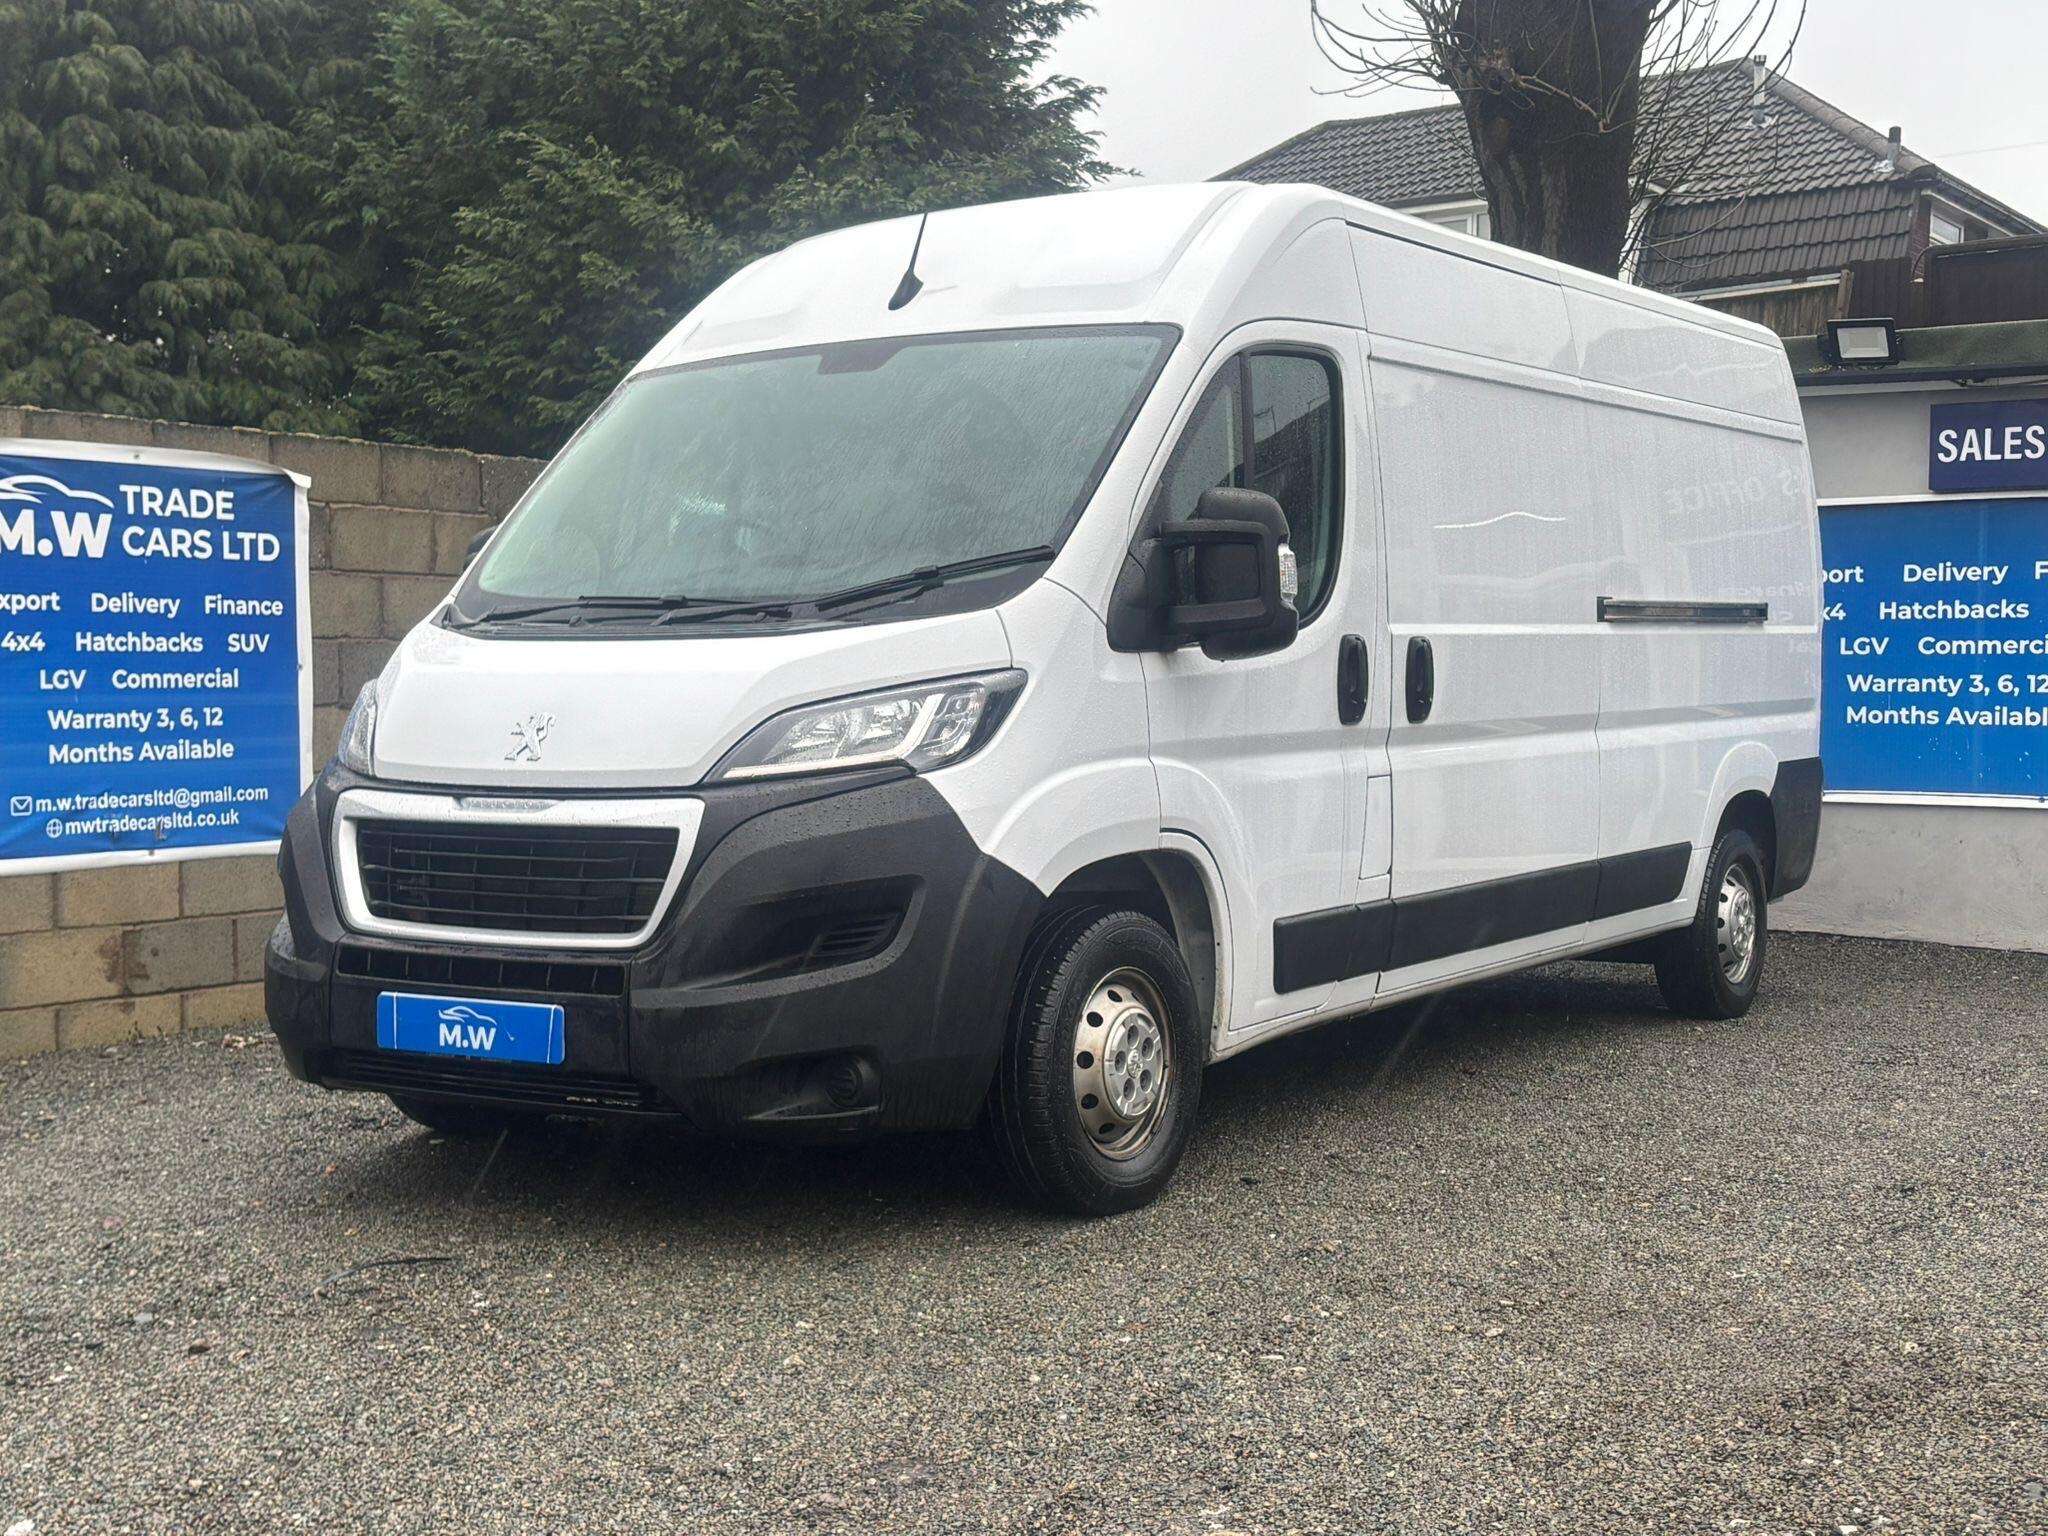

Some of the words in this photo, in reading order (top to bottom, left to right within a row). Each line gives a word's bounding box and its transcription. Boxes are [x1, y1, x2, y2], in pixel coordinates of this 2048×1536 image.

[1937, 425, 2046, 463] SALES
[119, 484, 235, 521] TRADE
[0, 509, 113, 559] M.W
[122, 527, 213, 560] CARS
[222, 530, 280, 562] LTD
[1903, 562, 2009, 585] Delivery
[91, 592, 181, 619] Delivery
[204, 594, 283, 617] Finance
[1879, 599, 2030, 620] Hatchbacks
[1, 630, 45, 652] 4x4
[75, 631, 204, 653] Hatchbacks
[228, 633, 270, 653] SUV
[1839, 637, 1889, 655] LGV
[1917, 633, 2048, 655] Commerci
[40, 669, 87, 690] LGV
[112, 666, 239, 689] Commercial
[1846, 674, 1963, 697] Warranty
[1968, 674, 1990, 697] 3,
[1997, 674, 2020, 697] 6,
[2027, 674, 2048, 693] 12
[47, 709, 152, 733] Warranty
[156, 708, 175, 730] 3,
[180, 707, 199, 730] 6,
[203, 706, 223, 727] 12
[1846, 705, 1939, 725] Months
[1945, 705, 2048, 727] Availabl
[49, 742, 134, 765] Months
[139, 738, 234, 762] Available
[35, 785, 269, 813] m.w.tradecarsltd@gmail.com
[65, 808, 240, 836] mwtradecarsltd.co.uk
[438, 1022, 497, 1051] M.W
